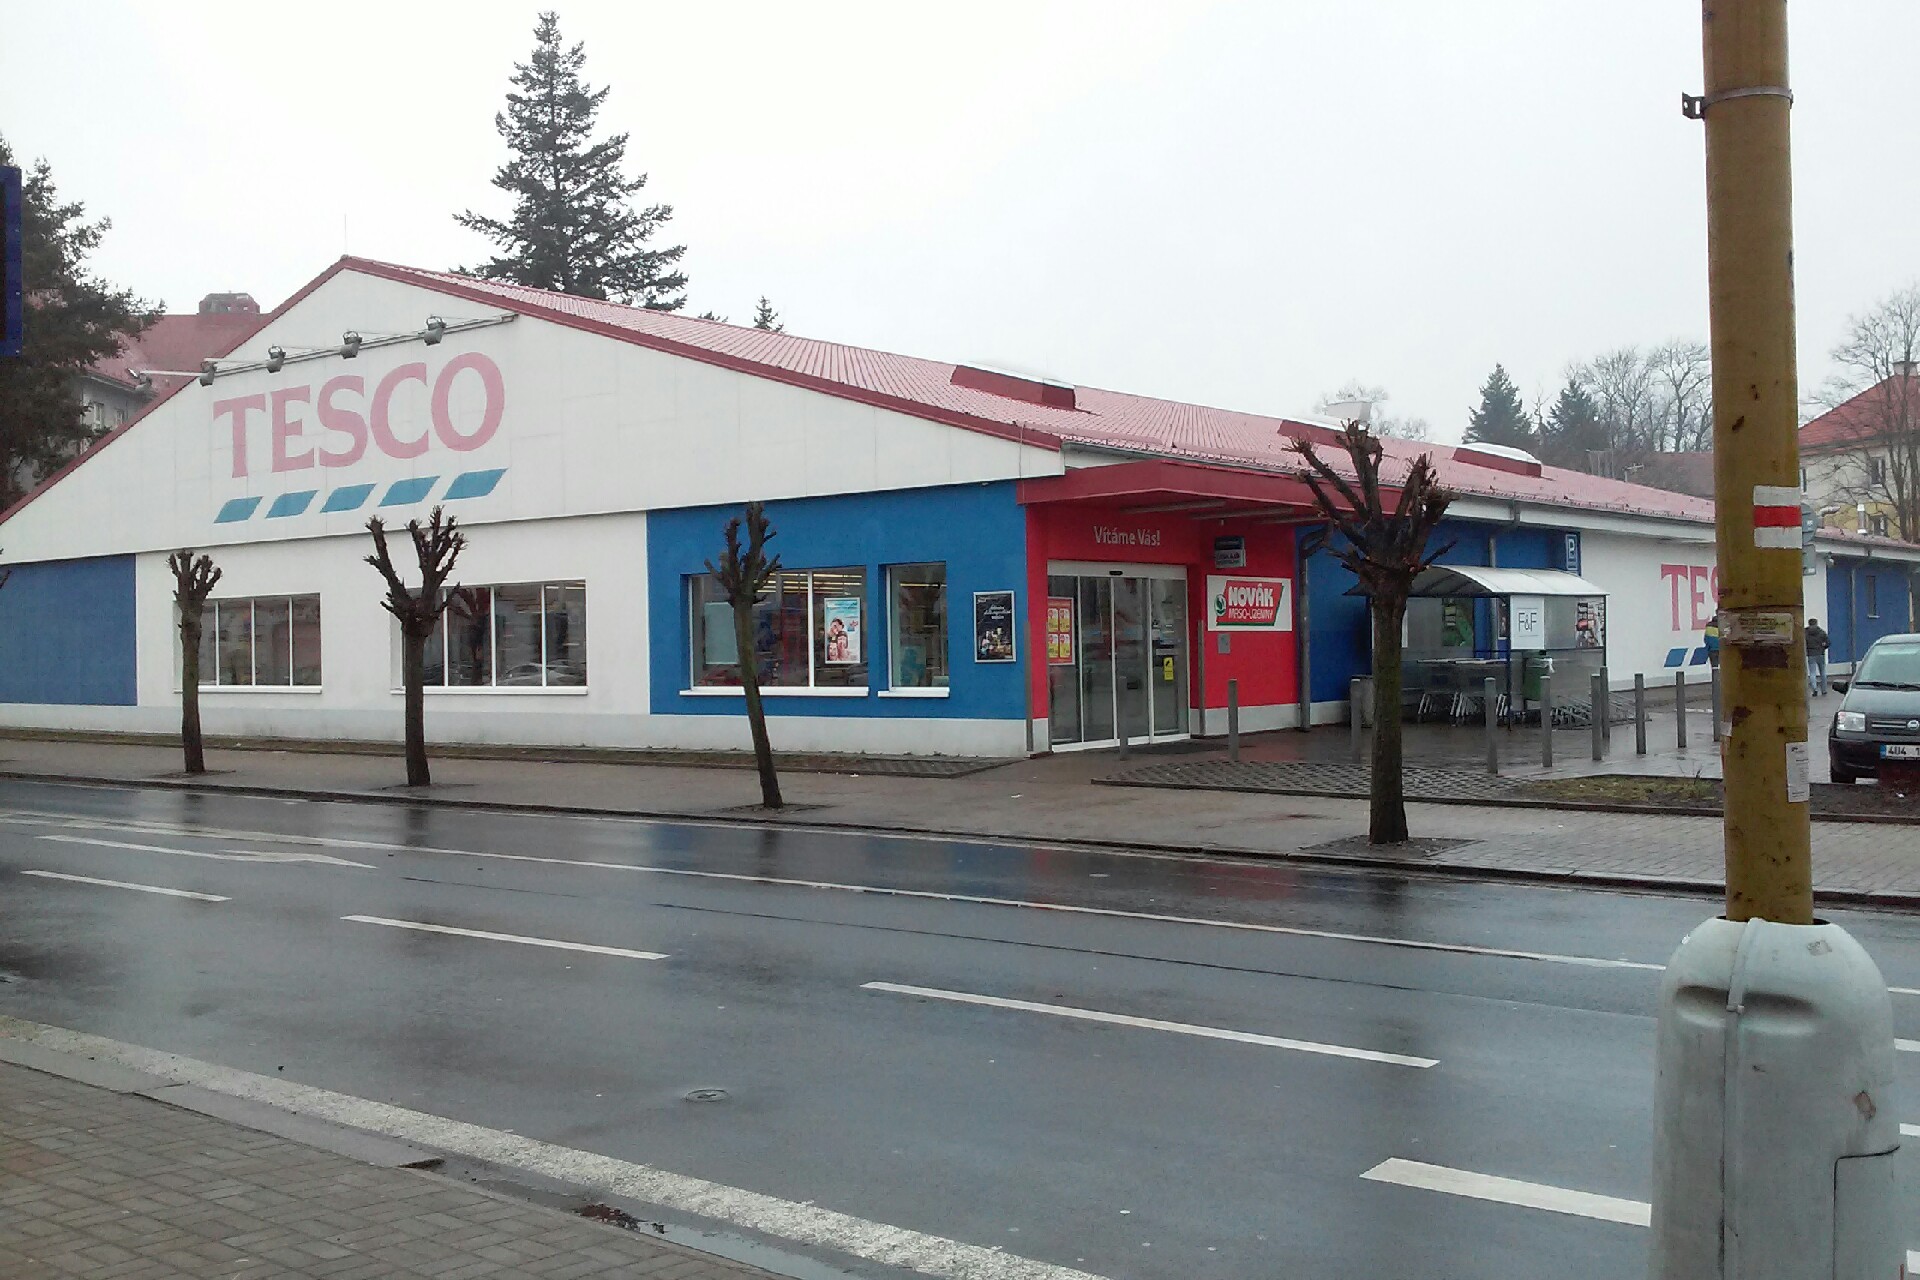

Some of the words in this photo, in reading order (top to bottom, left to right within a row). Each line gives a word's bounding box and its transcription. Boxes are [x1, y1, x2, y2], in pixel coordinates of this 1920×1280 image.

[213, 352, 505, 478] TESCO
[1093, 525, 1136, 545] Vítáme
[1137, 528, 1161, 546] Vás!
[1228, 583, 1274, 608] NOVÁK
[1518, 611, 1537, 633] F&F
